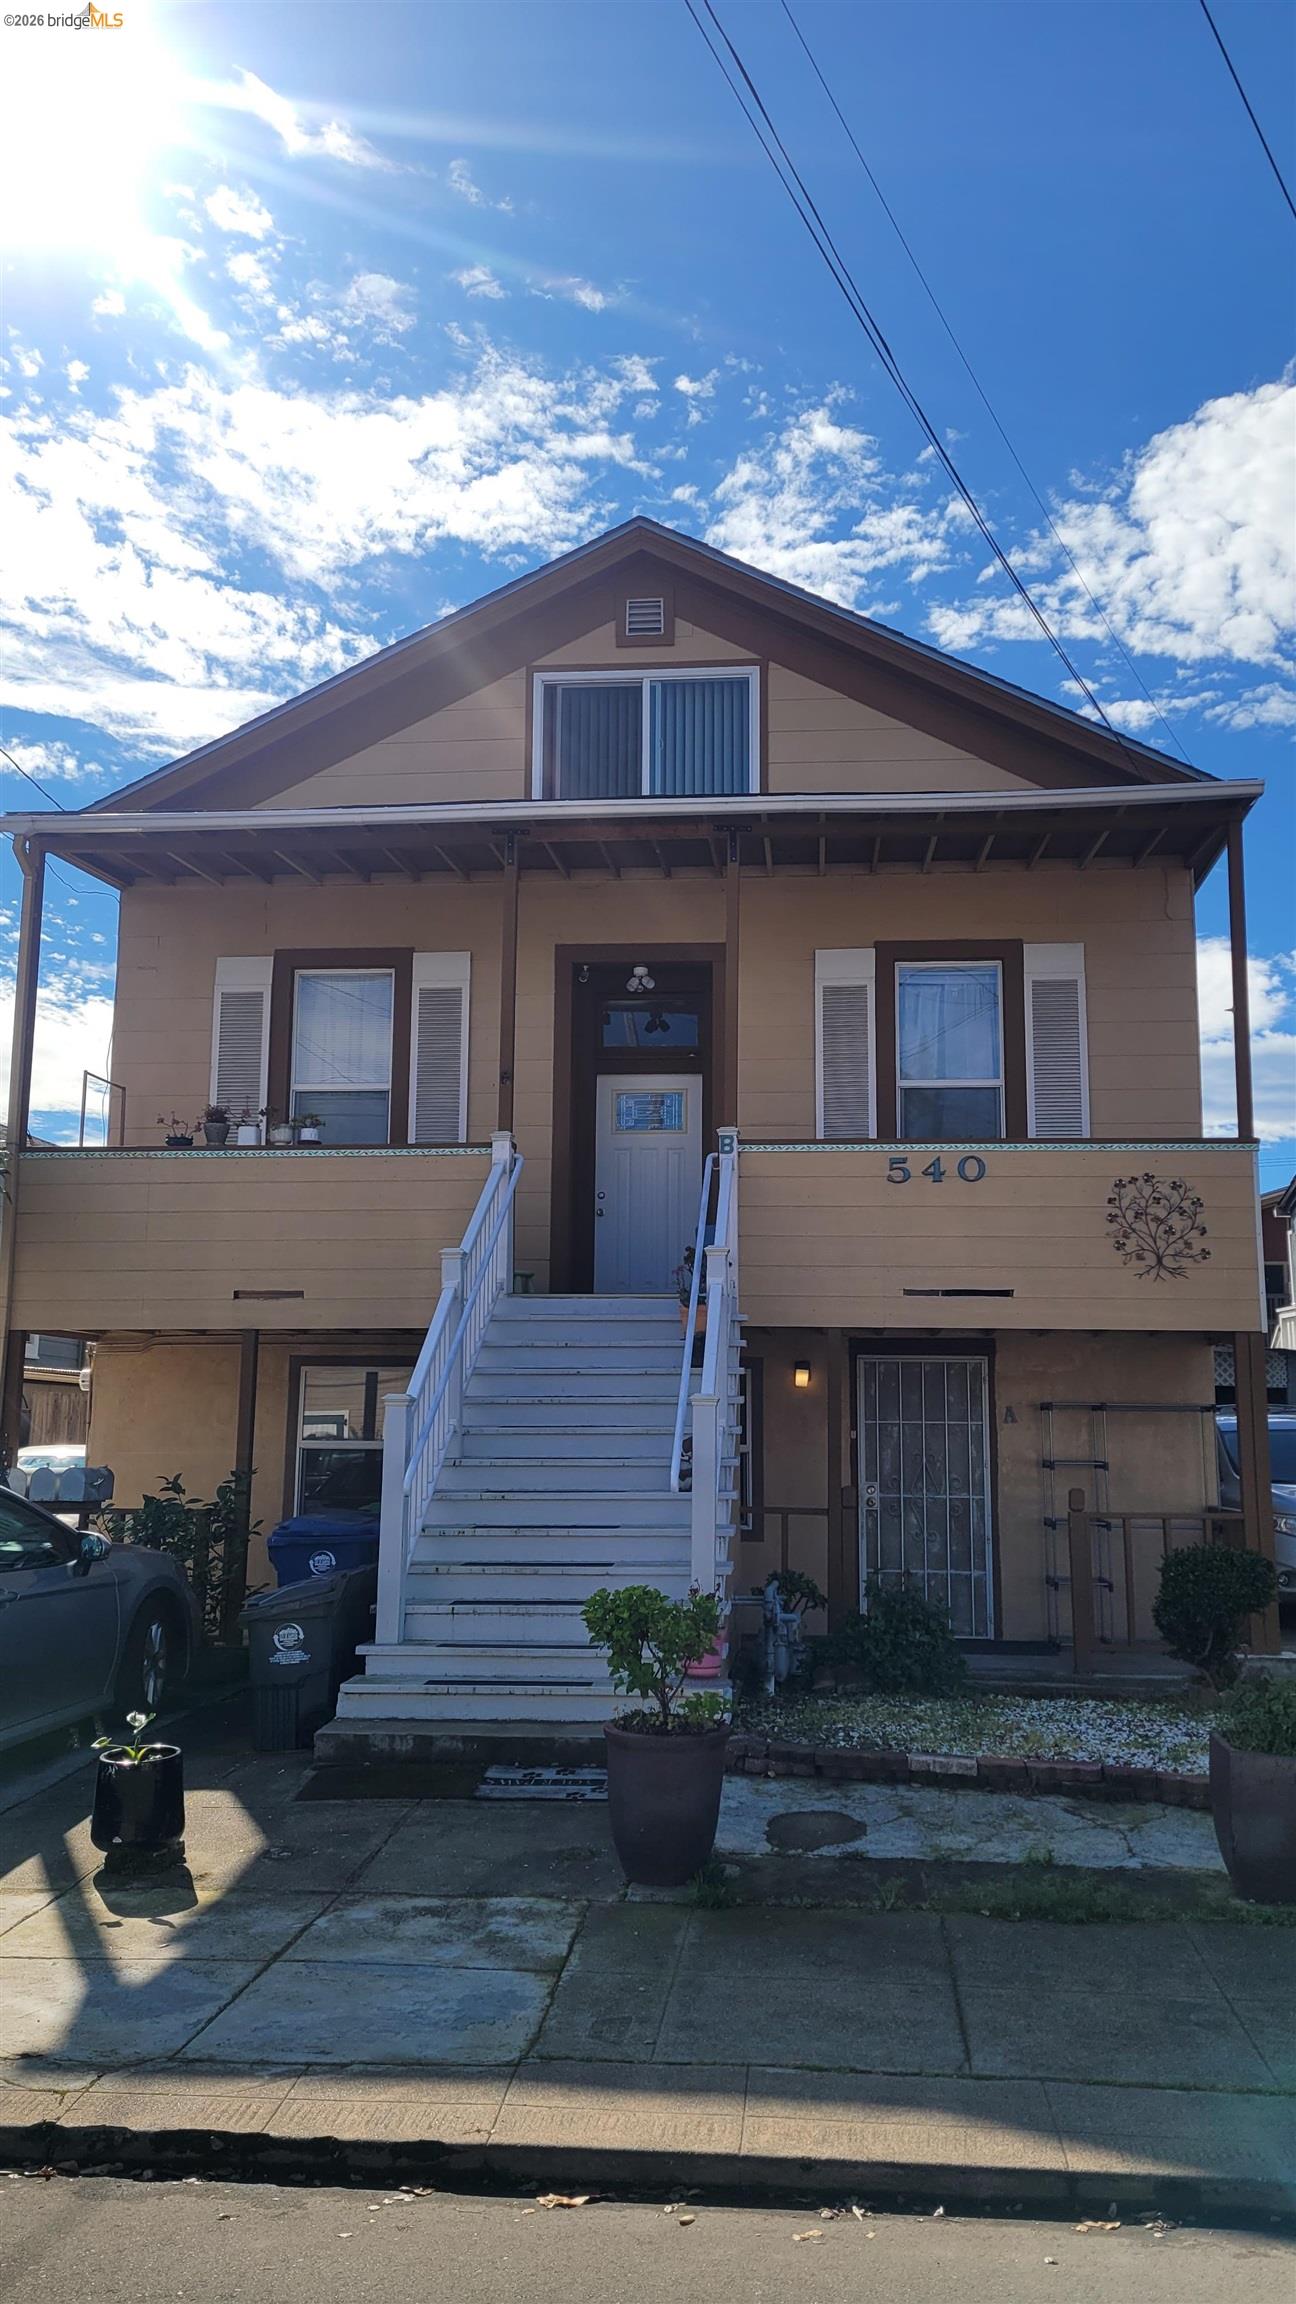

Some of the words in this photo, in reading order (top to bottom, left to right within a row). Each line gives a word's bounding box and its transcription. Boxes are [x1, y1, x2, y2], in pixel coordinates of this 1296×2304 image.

[720, 1135, 734, 1154] B
[886, 1155, 987, 1184] 540
[1003, 1405, 1019, 1425] A
